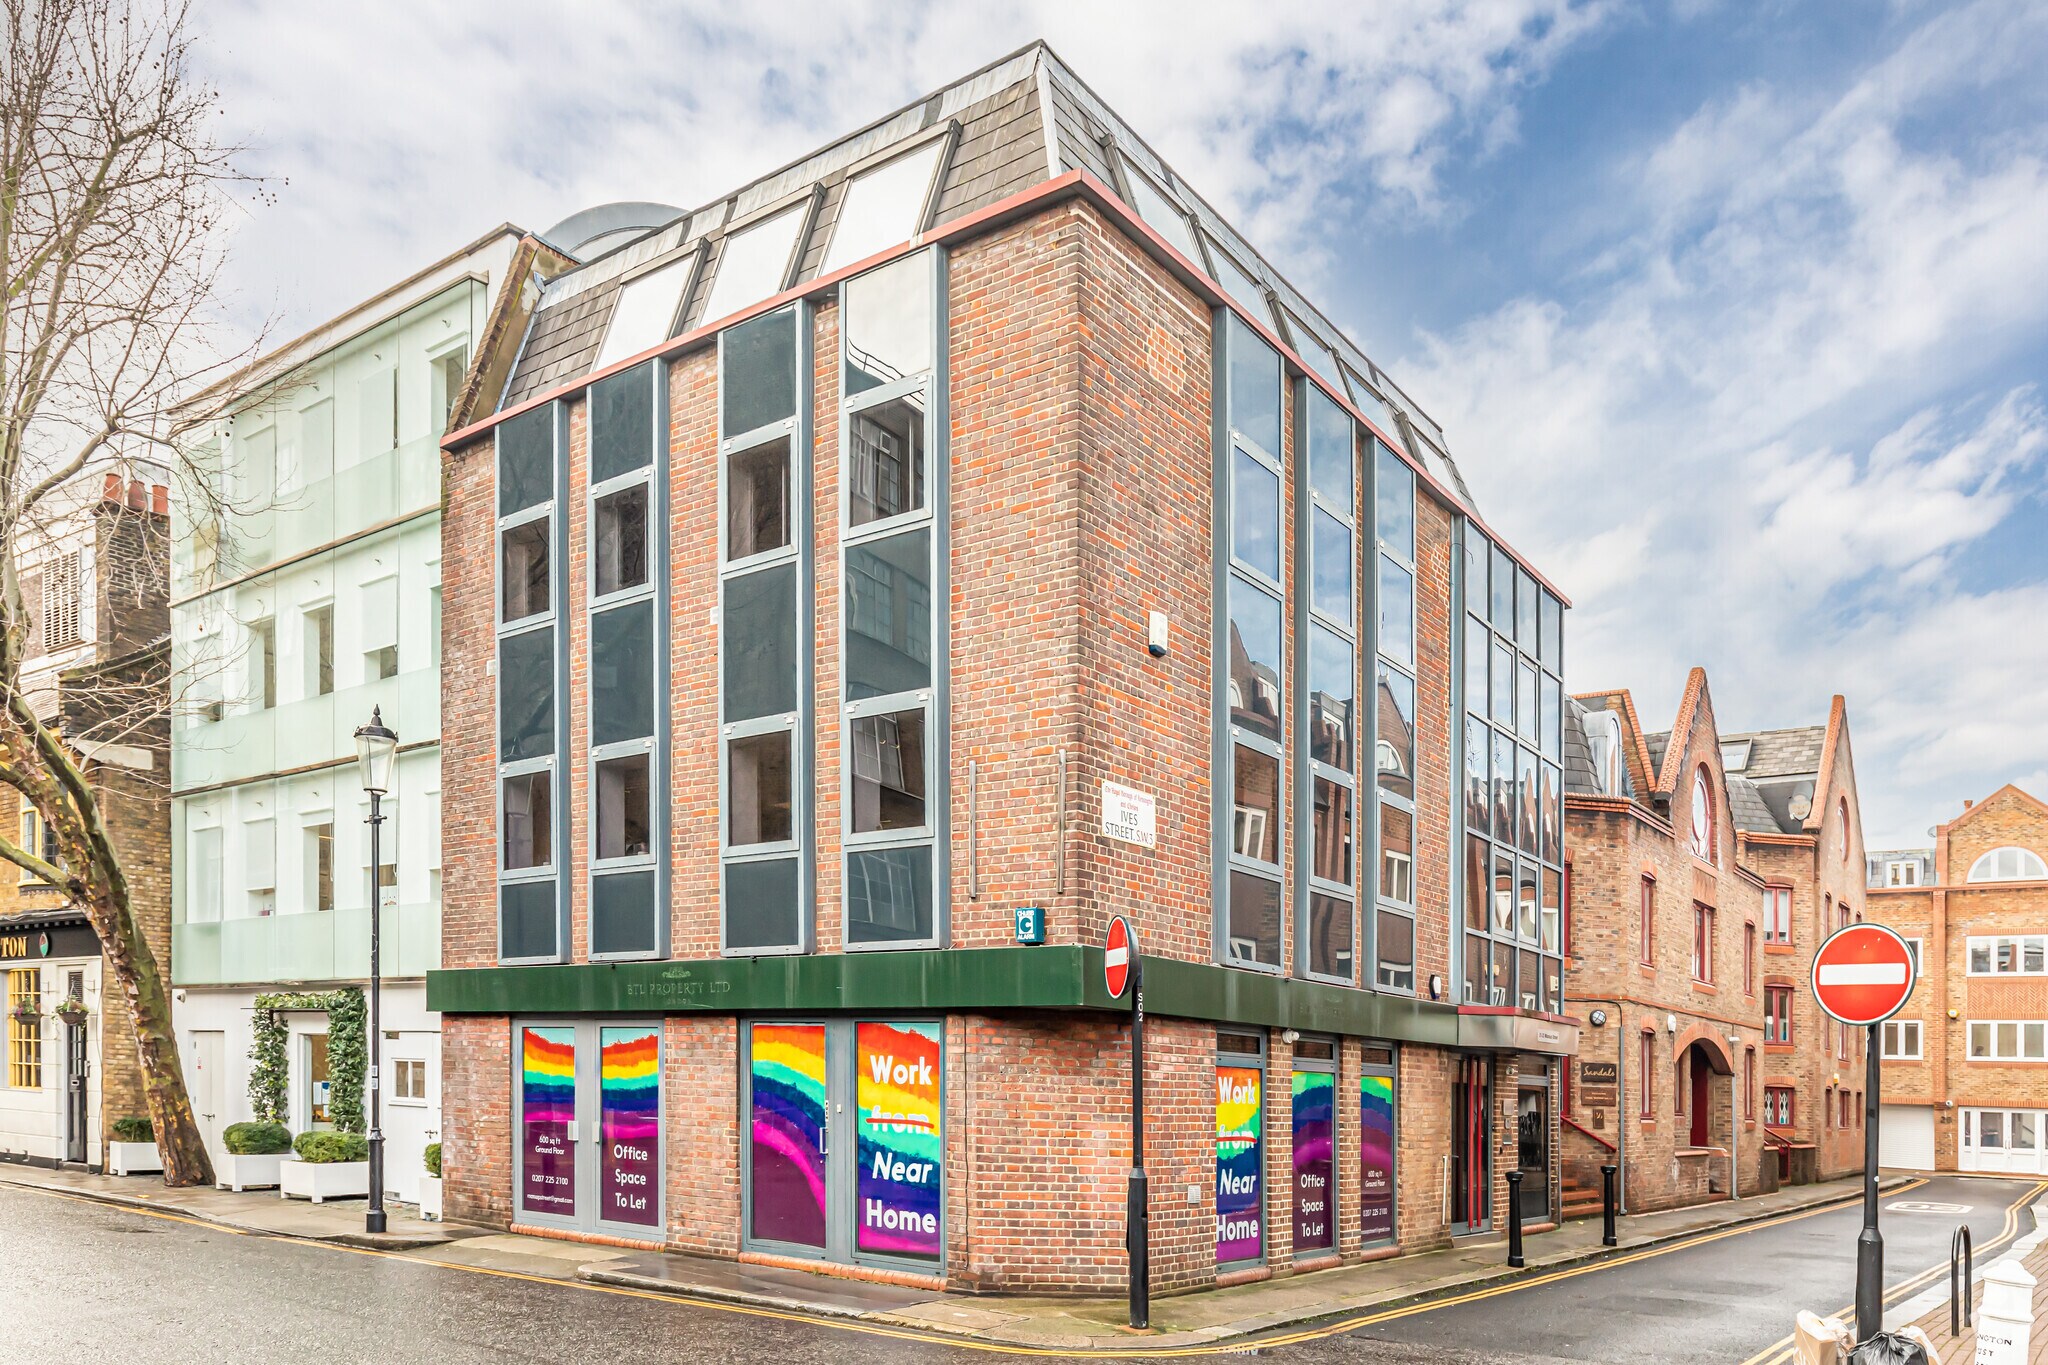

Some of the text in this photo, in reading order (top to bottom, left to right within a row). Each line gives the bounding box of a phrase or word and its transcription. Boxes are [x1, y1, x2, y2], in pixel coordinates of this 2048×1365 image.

[1121, 810, 1138, 826] IVES
[0, 936, 27, 957] TON
[650, 982, 704, 996] PROPERTY
[710, 981, 730, 993] LTD
[869, 1054, 932, 1086] Work
[1218, 1076, 1256, 1104] Work
[871, 1105, 930, 1135] from
[539, 1135, 561, 1146] 600 sq ft
[1218, 1124, 1255, 1150] from
[535, 1145, 565, 1155] Ground Floor
[613, 1144, 648, 1161] Office
[872, 1151, 933, 1184] Near
[531, 1174, 569, 1185] 0207 225 2100
[615, 1168, 647, 1187] Space
[1219, 1168, 1256, 1196] Near
[1300, 1174, 1325, 1189] Office
[615, 1192, 647, 1210] To Let
[1301, 1198, 1324, 1216] Space
[866, 1198, 937, 1234] Home
[1216, 1214, 1258, 1242] Home
[1301, 1221, 1324, 1237] To Let
